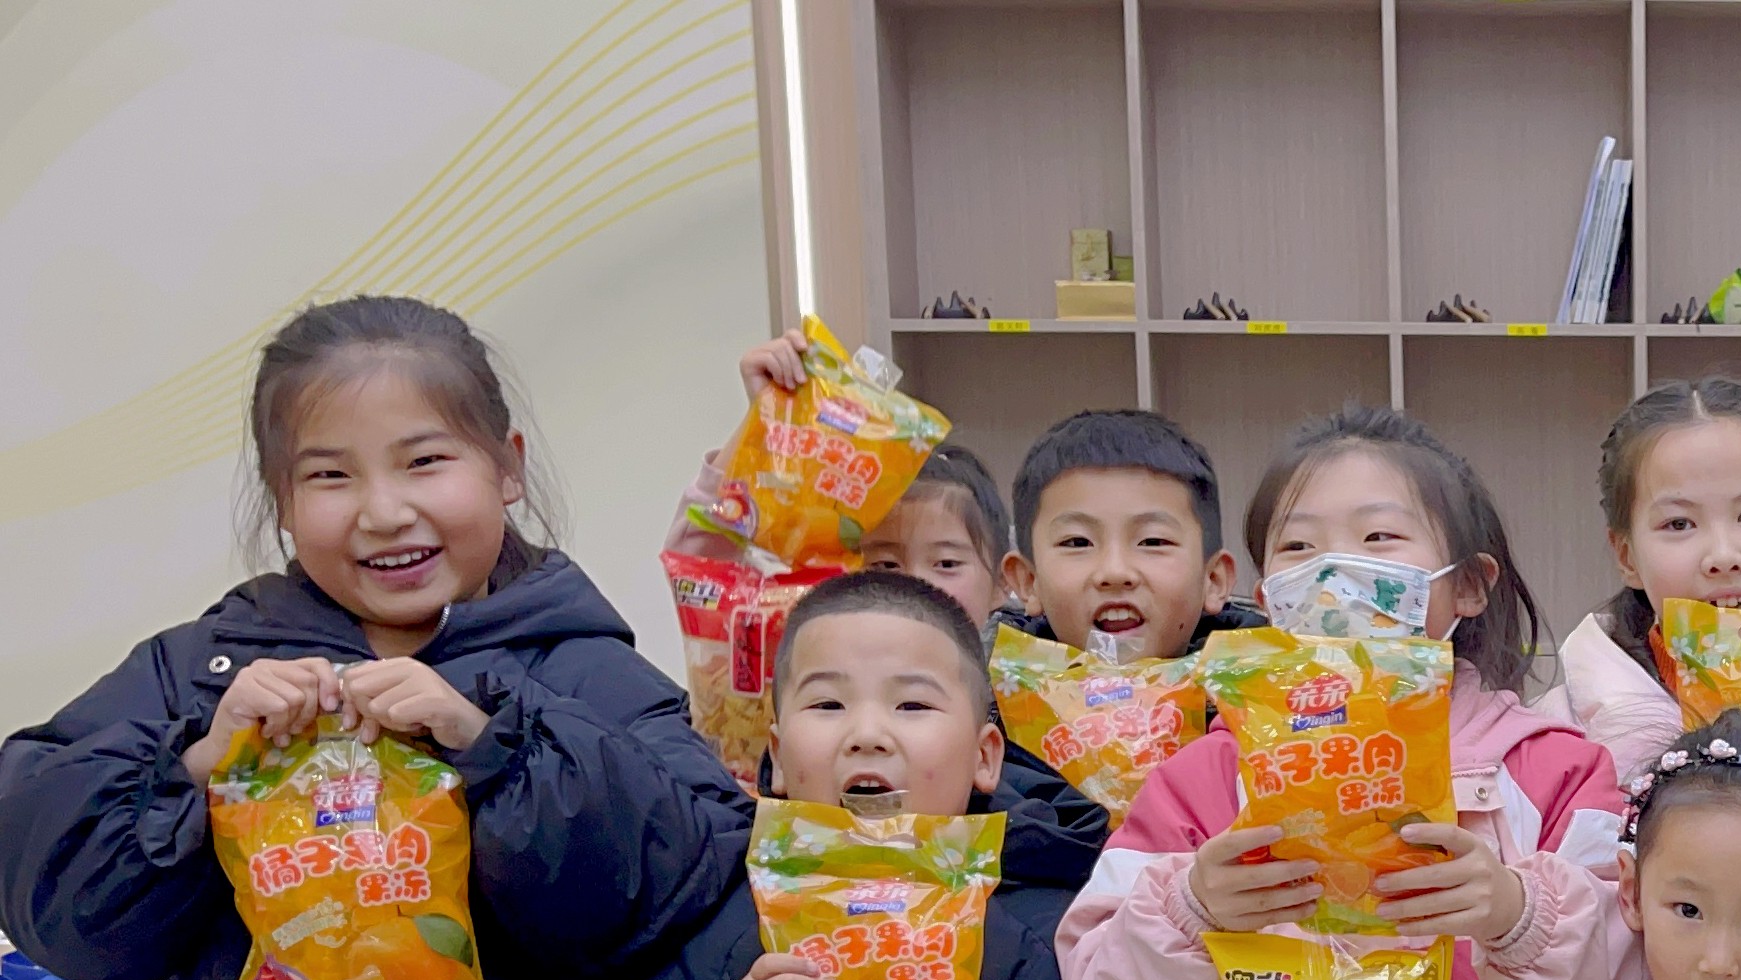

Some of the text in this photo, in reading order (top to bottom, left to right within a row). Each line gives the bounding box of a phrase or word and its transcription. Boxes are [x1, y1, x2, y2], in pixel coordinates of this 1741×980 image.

[1246, 730, 1407, 798] 橘子果肉
[1337, 776, 1405, 815] 果冻
[251, 824, 429, 895] 橘子果肉
[358, 870, 430, 905] 果冻
